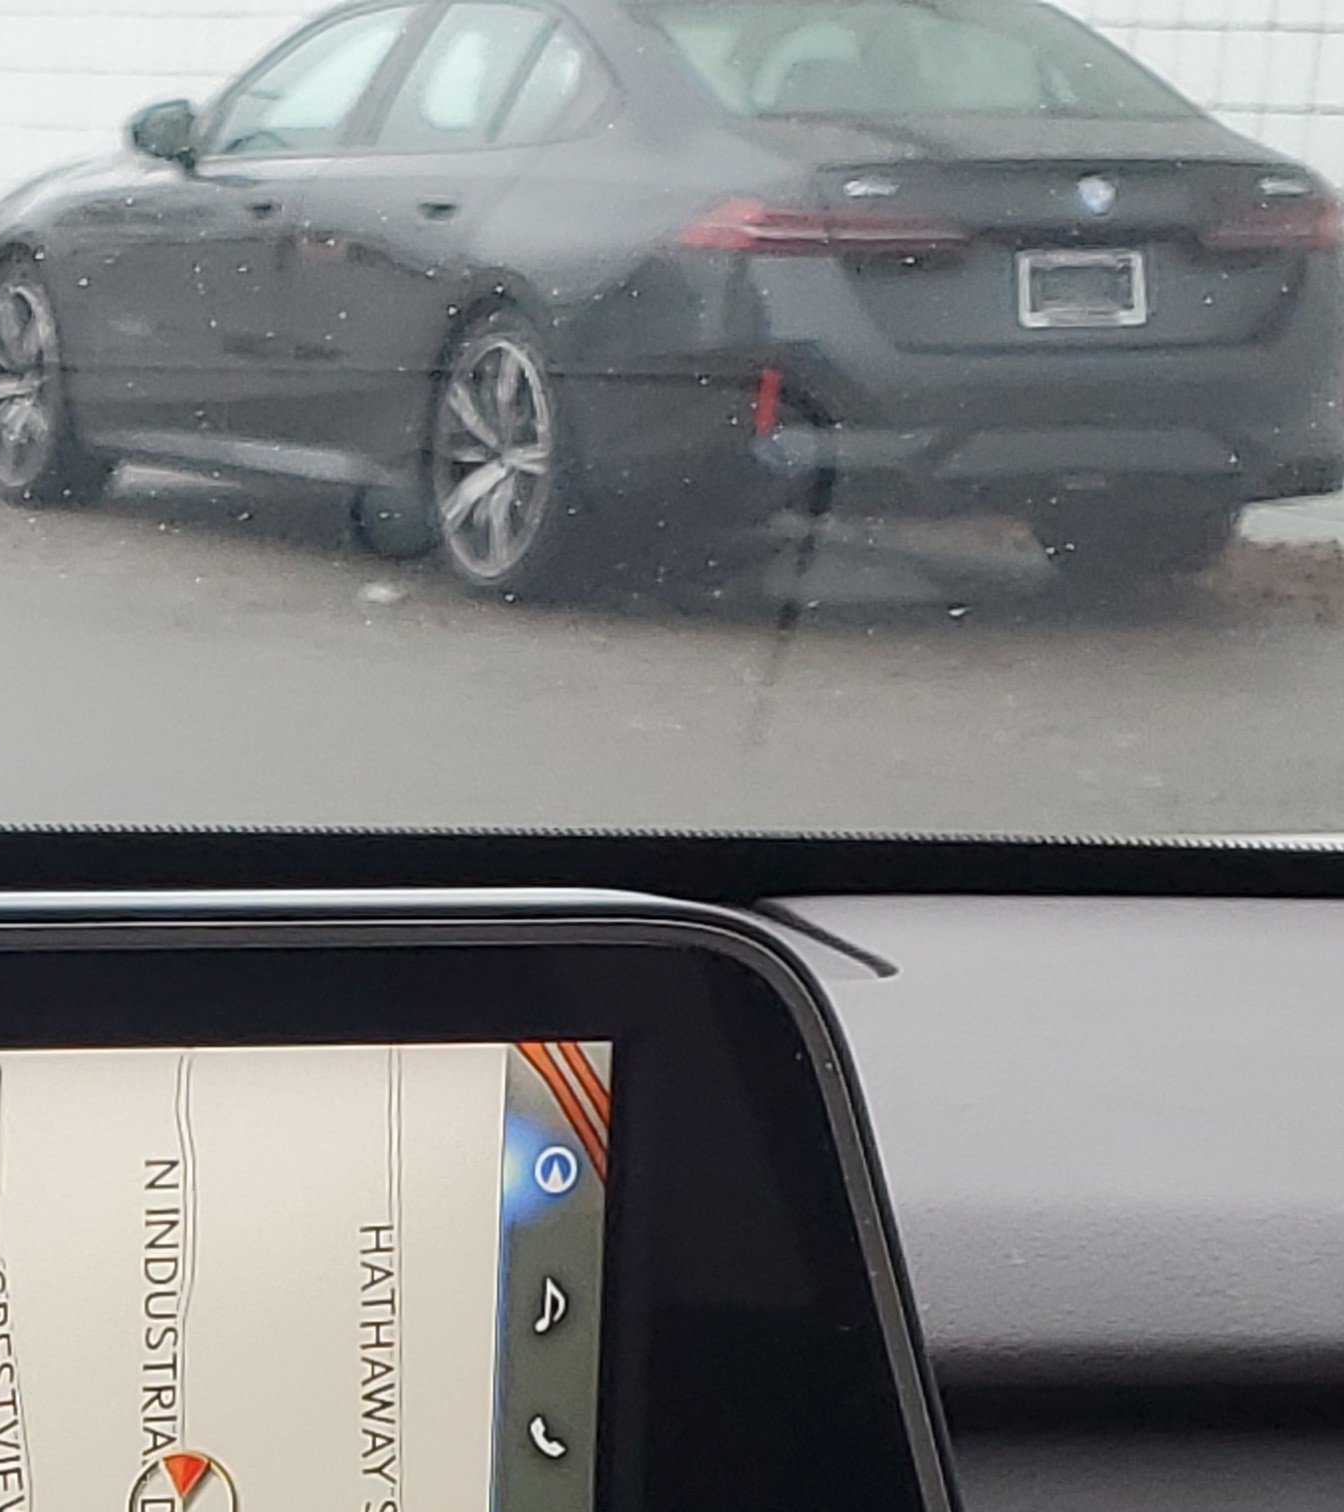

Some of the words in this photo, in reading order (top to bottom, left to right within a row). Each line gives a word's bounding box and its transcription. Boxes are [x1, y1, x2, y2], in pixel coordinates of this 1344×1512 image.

[146, 1159, 179, 1189] N
[141, 1210, 179, 1482] INDUSTRIA
[359, 1223, 398, 1485] HATHAWAY
